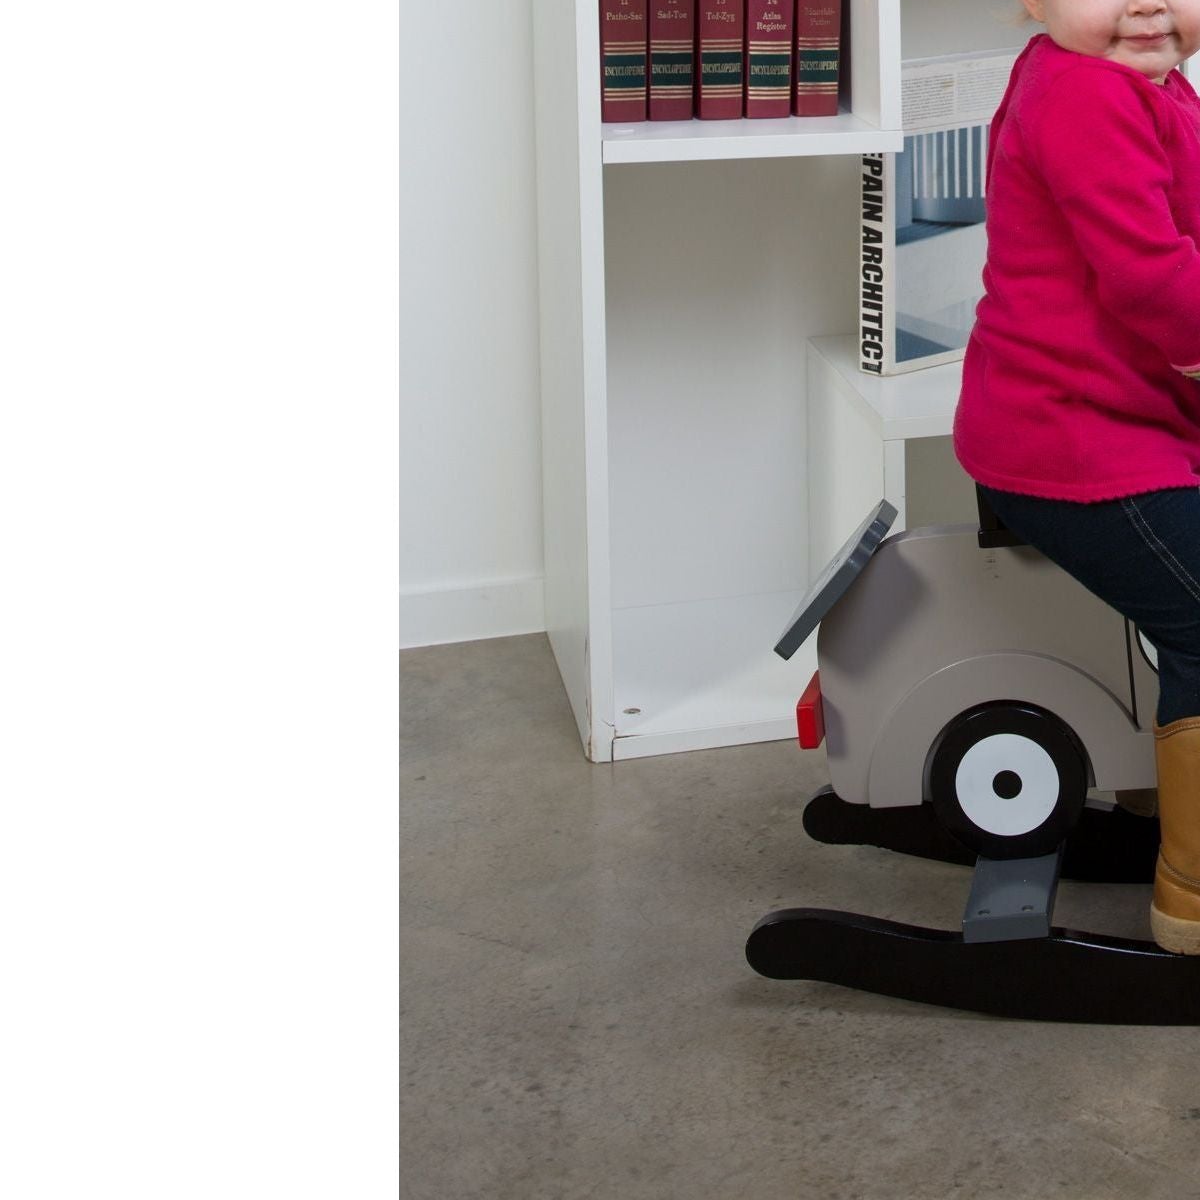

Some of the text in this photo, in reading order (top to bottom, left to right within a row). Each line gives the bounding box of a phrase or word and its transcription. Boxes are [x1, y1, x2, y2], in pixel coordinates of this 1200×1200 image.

[762, 12, 781, 20] Atlas
[605, 65, 645, 76] ENCYCLOPEDIE
[651, 63, 693, 74] ENCYCLOPEDIE
[702, 62, 741, 73] ENCYCLOPEDIE
[751, 64, 790, 75] ENCYCLOPEDIE
[800, 60, 839, 71] ENCYCLOPEDIE
[861, 153, 883, 374] PAIN ARCHITECT
